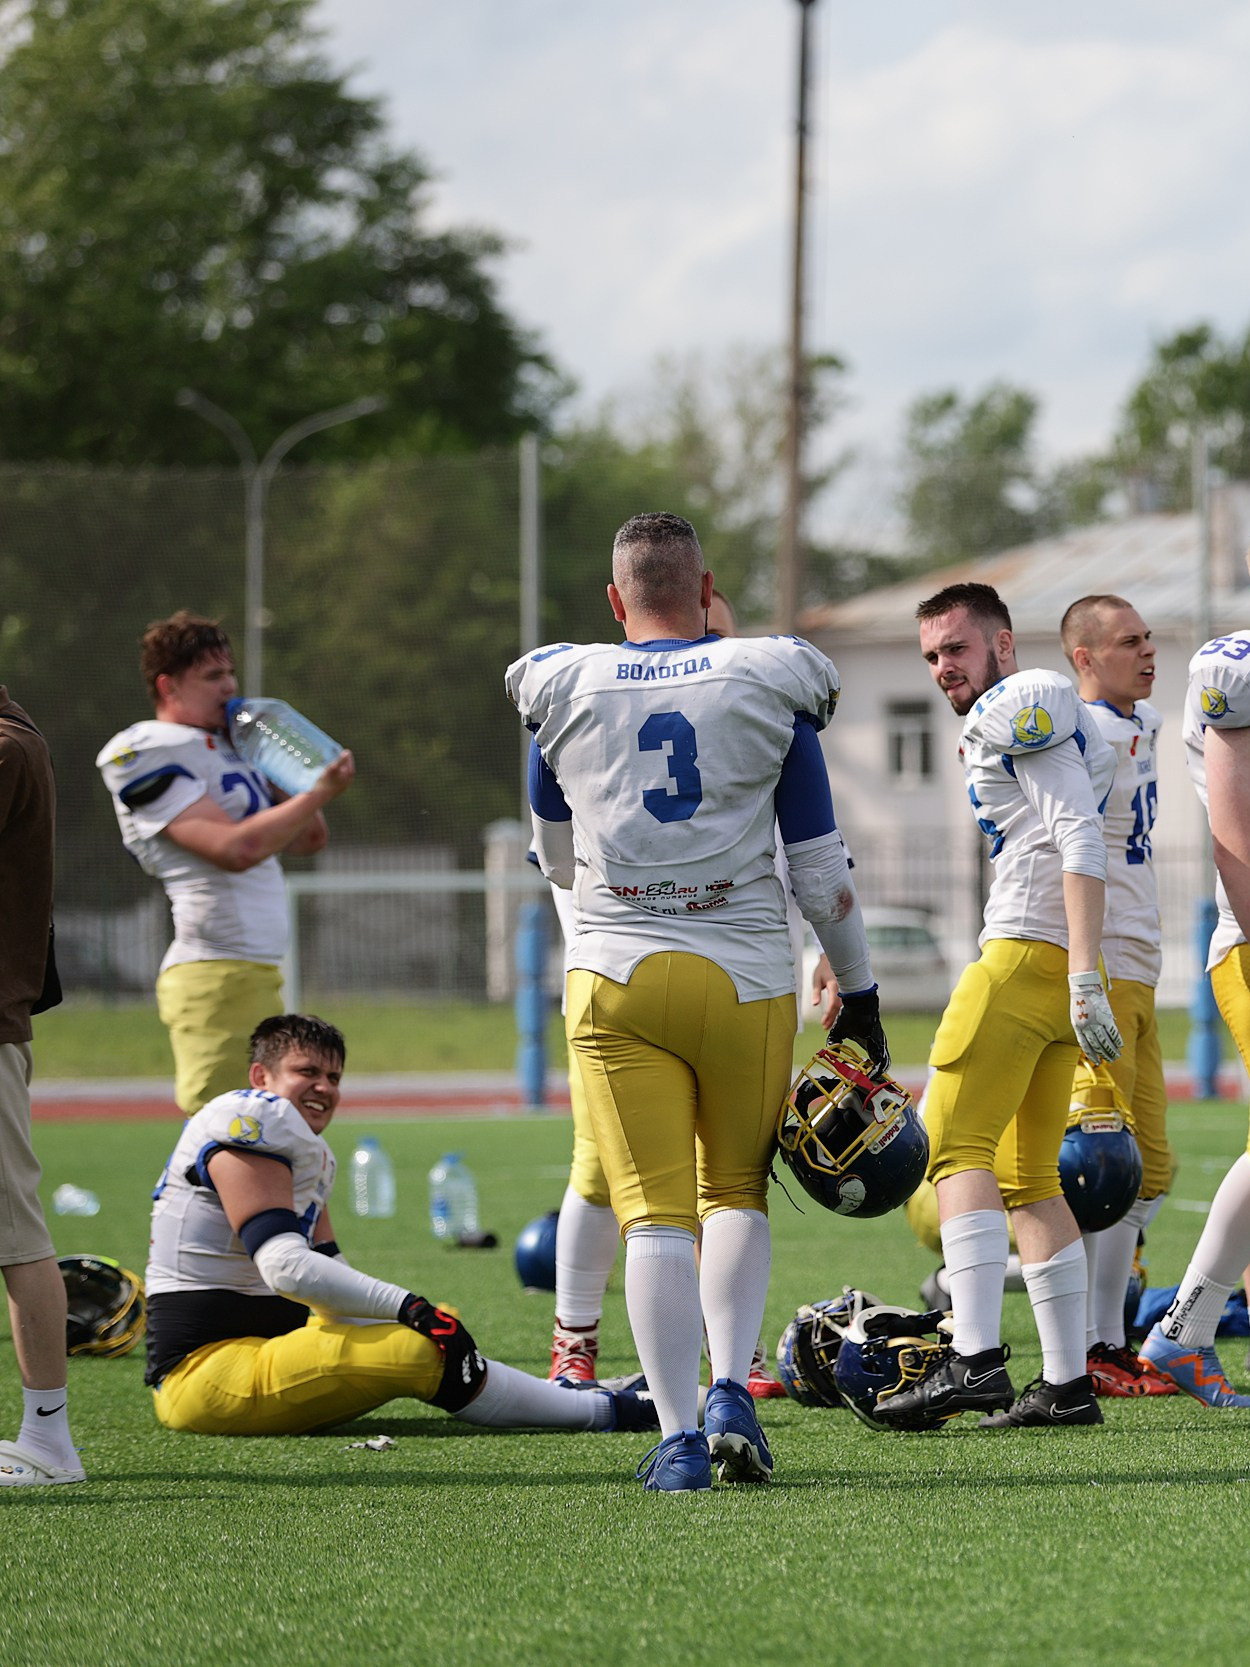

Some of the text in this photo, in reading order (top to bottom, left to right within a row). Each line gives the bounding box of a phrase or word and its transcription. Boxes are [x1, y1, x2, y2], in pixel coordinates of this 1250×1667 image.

[616, 656, 712, 681] ВОЛОГДА
[638, 711, 702, 823] 3
[878, 1124, 900, 1147] Riddell
